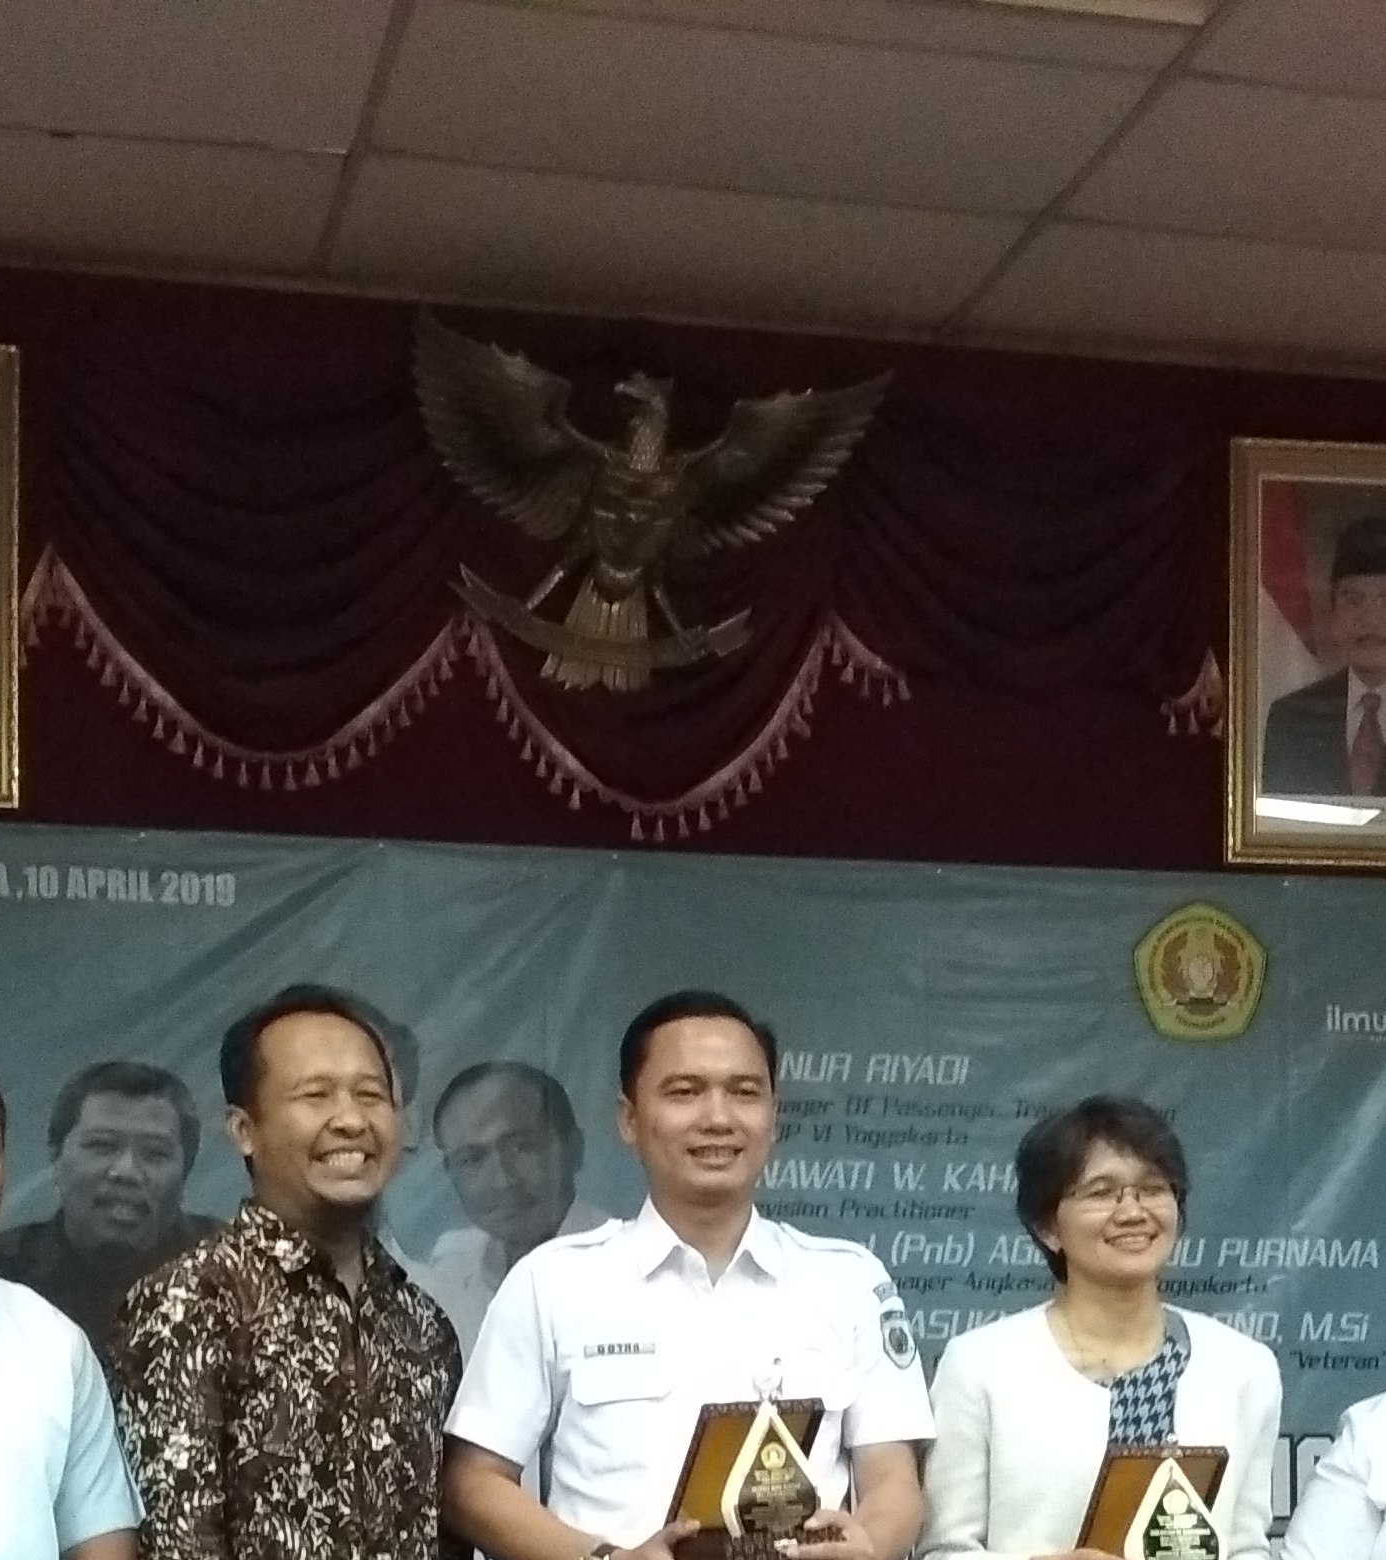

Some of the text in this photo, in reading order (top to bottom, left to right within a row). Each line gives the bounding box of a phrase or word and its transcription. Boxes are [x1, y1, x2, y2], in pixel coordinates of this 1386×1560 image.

[66, 866, 153, 902] APRIL
[161, 871, 236, 907] 2019
[865, 1052, 969, 1086] RIYADI
[845, 1124, 968, 1149] Yogyakarta
[755, 1160, 1017, 1194] NAWATI W. KAH
[840, 1199, 975, 1219] Practitioner
[891, 1230, 974, 1267] (Pnb)
[1218, 1237, 1379, 1269] PURNAMA
[1156, 1274, 1267, 1298] ogyakarta
[1300, 1311, 1370, 1343] M.Si
